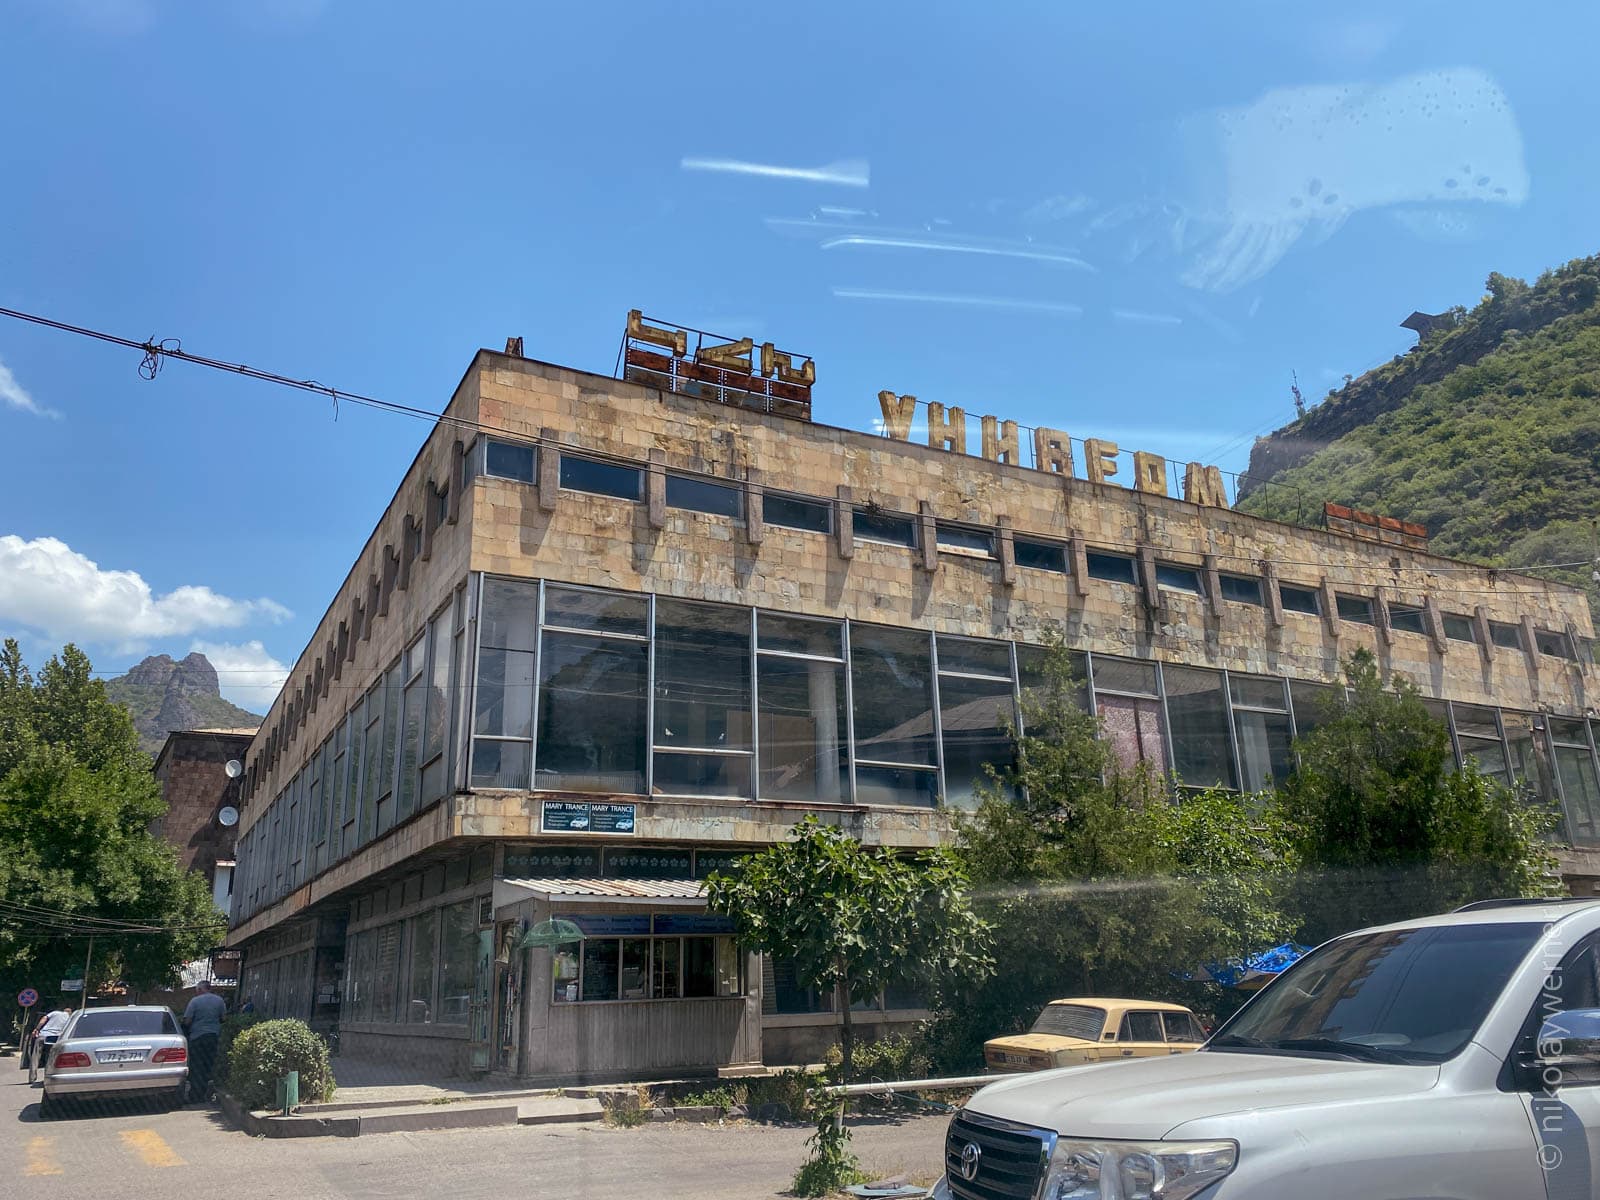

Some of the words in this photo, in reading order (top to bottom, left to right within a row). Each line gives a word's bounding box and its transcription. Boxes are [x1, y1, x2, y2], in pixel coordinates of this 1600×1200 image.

[545, 802, 563, 810] MARY
[591, 804, 609, 812] MARY
[611, 805, 633, 813] TRANCE
